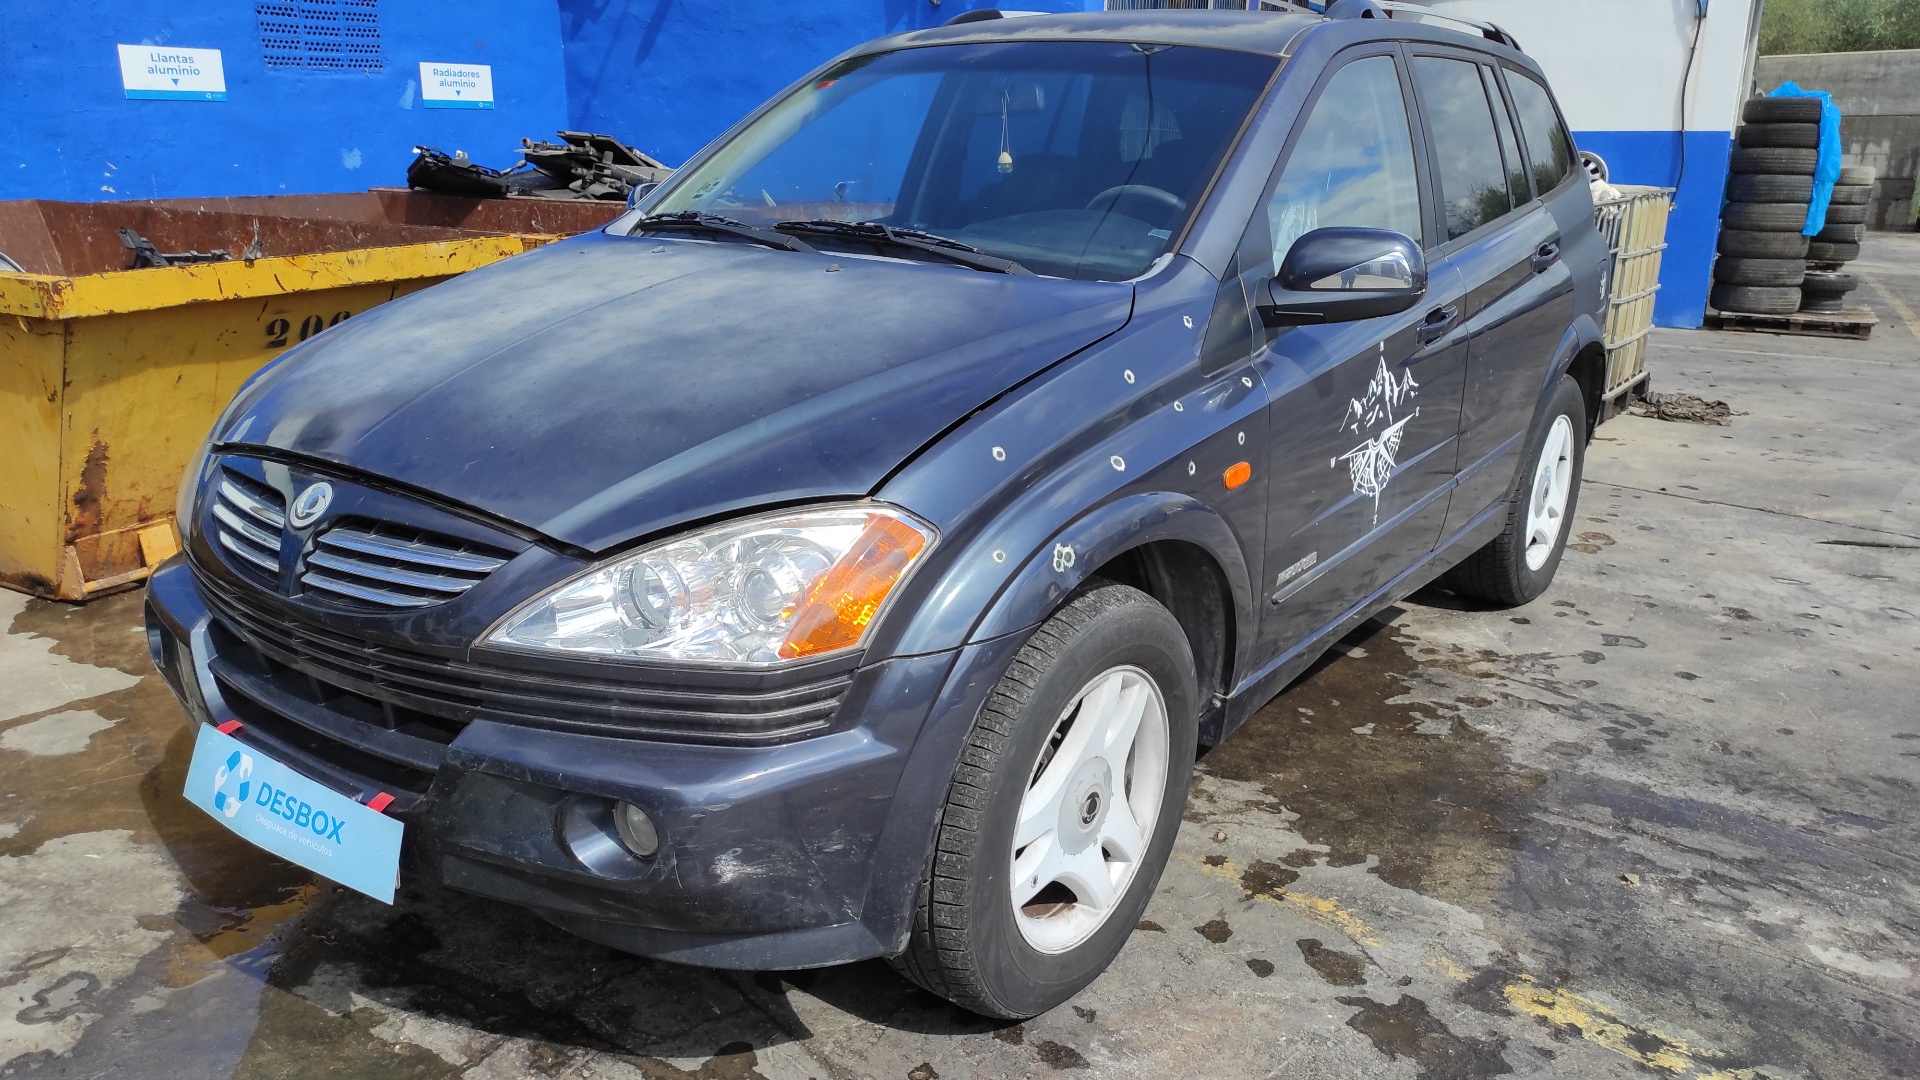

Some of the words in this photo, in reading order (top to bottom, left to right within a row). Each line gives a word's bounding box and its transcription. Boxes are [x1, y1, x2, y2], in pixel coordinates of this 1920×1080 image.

[150, 52, 195, 64] Llantas
[147, 64, 201, 76] aluminio
[432, 68, 480, 79] Radiadores
[439, 79, 476, 88] aluminio
[255, 781, 347, 845] DESBOX
[255, 813, 287, 835] Desguace
[288, 830, 297, 840] de
